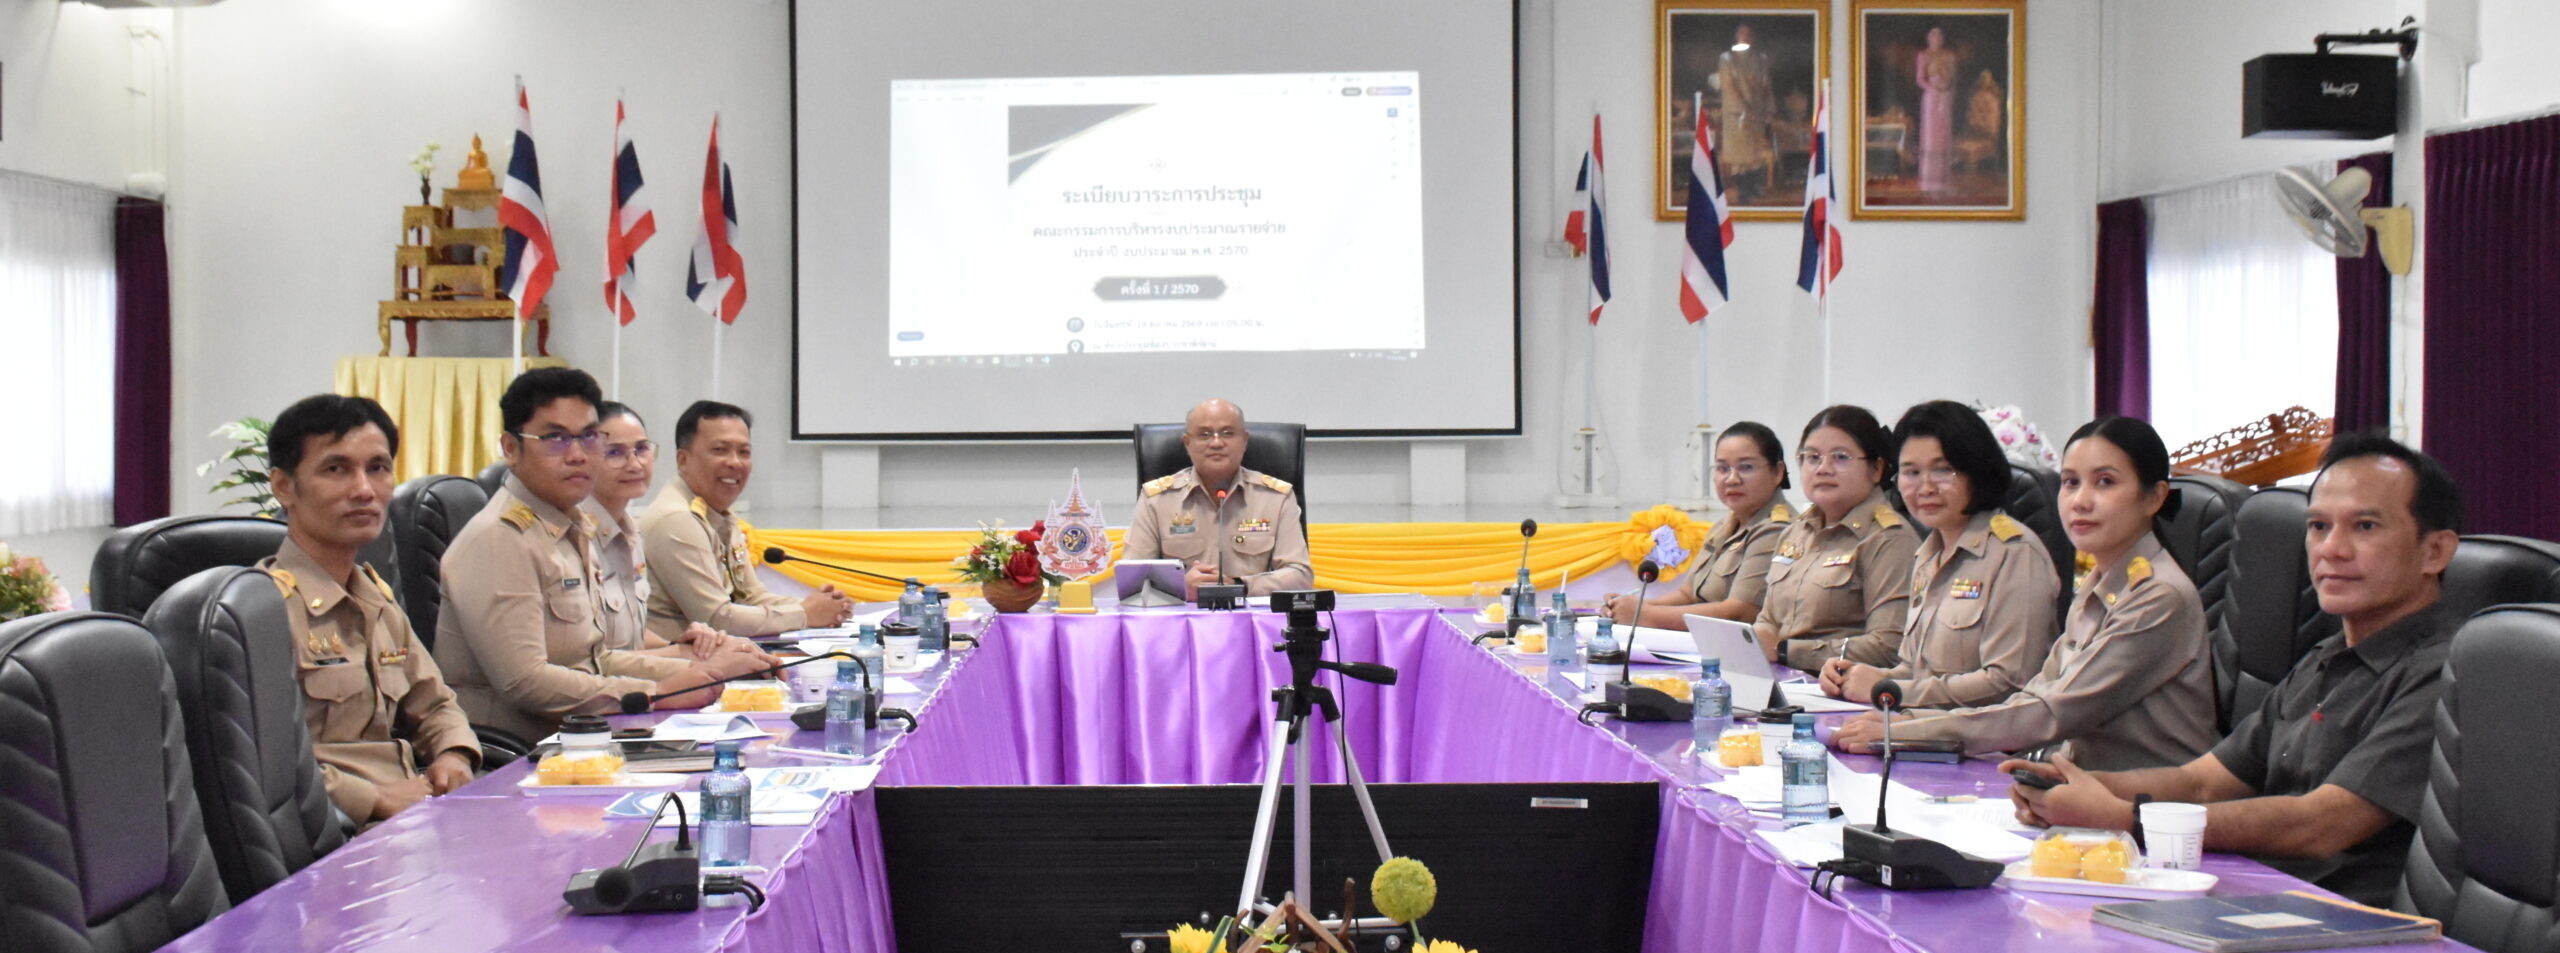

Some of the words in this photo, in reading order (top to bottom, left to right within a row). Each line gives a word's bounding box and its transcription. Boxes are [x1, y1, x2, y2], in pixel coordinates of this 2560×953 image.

[1062, 184, 1262, 208] ระเบียบวาระการประชุม
[1033, 220, 1286, 237] คณะกรรมการบริหารงบประมาณรายจ่าย
[1218, 245, 1248, 256] 2570
[1153, 284, 1160, 295] 1
[1170, 283, 1199, 295] 2570
